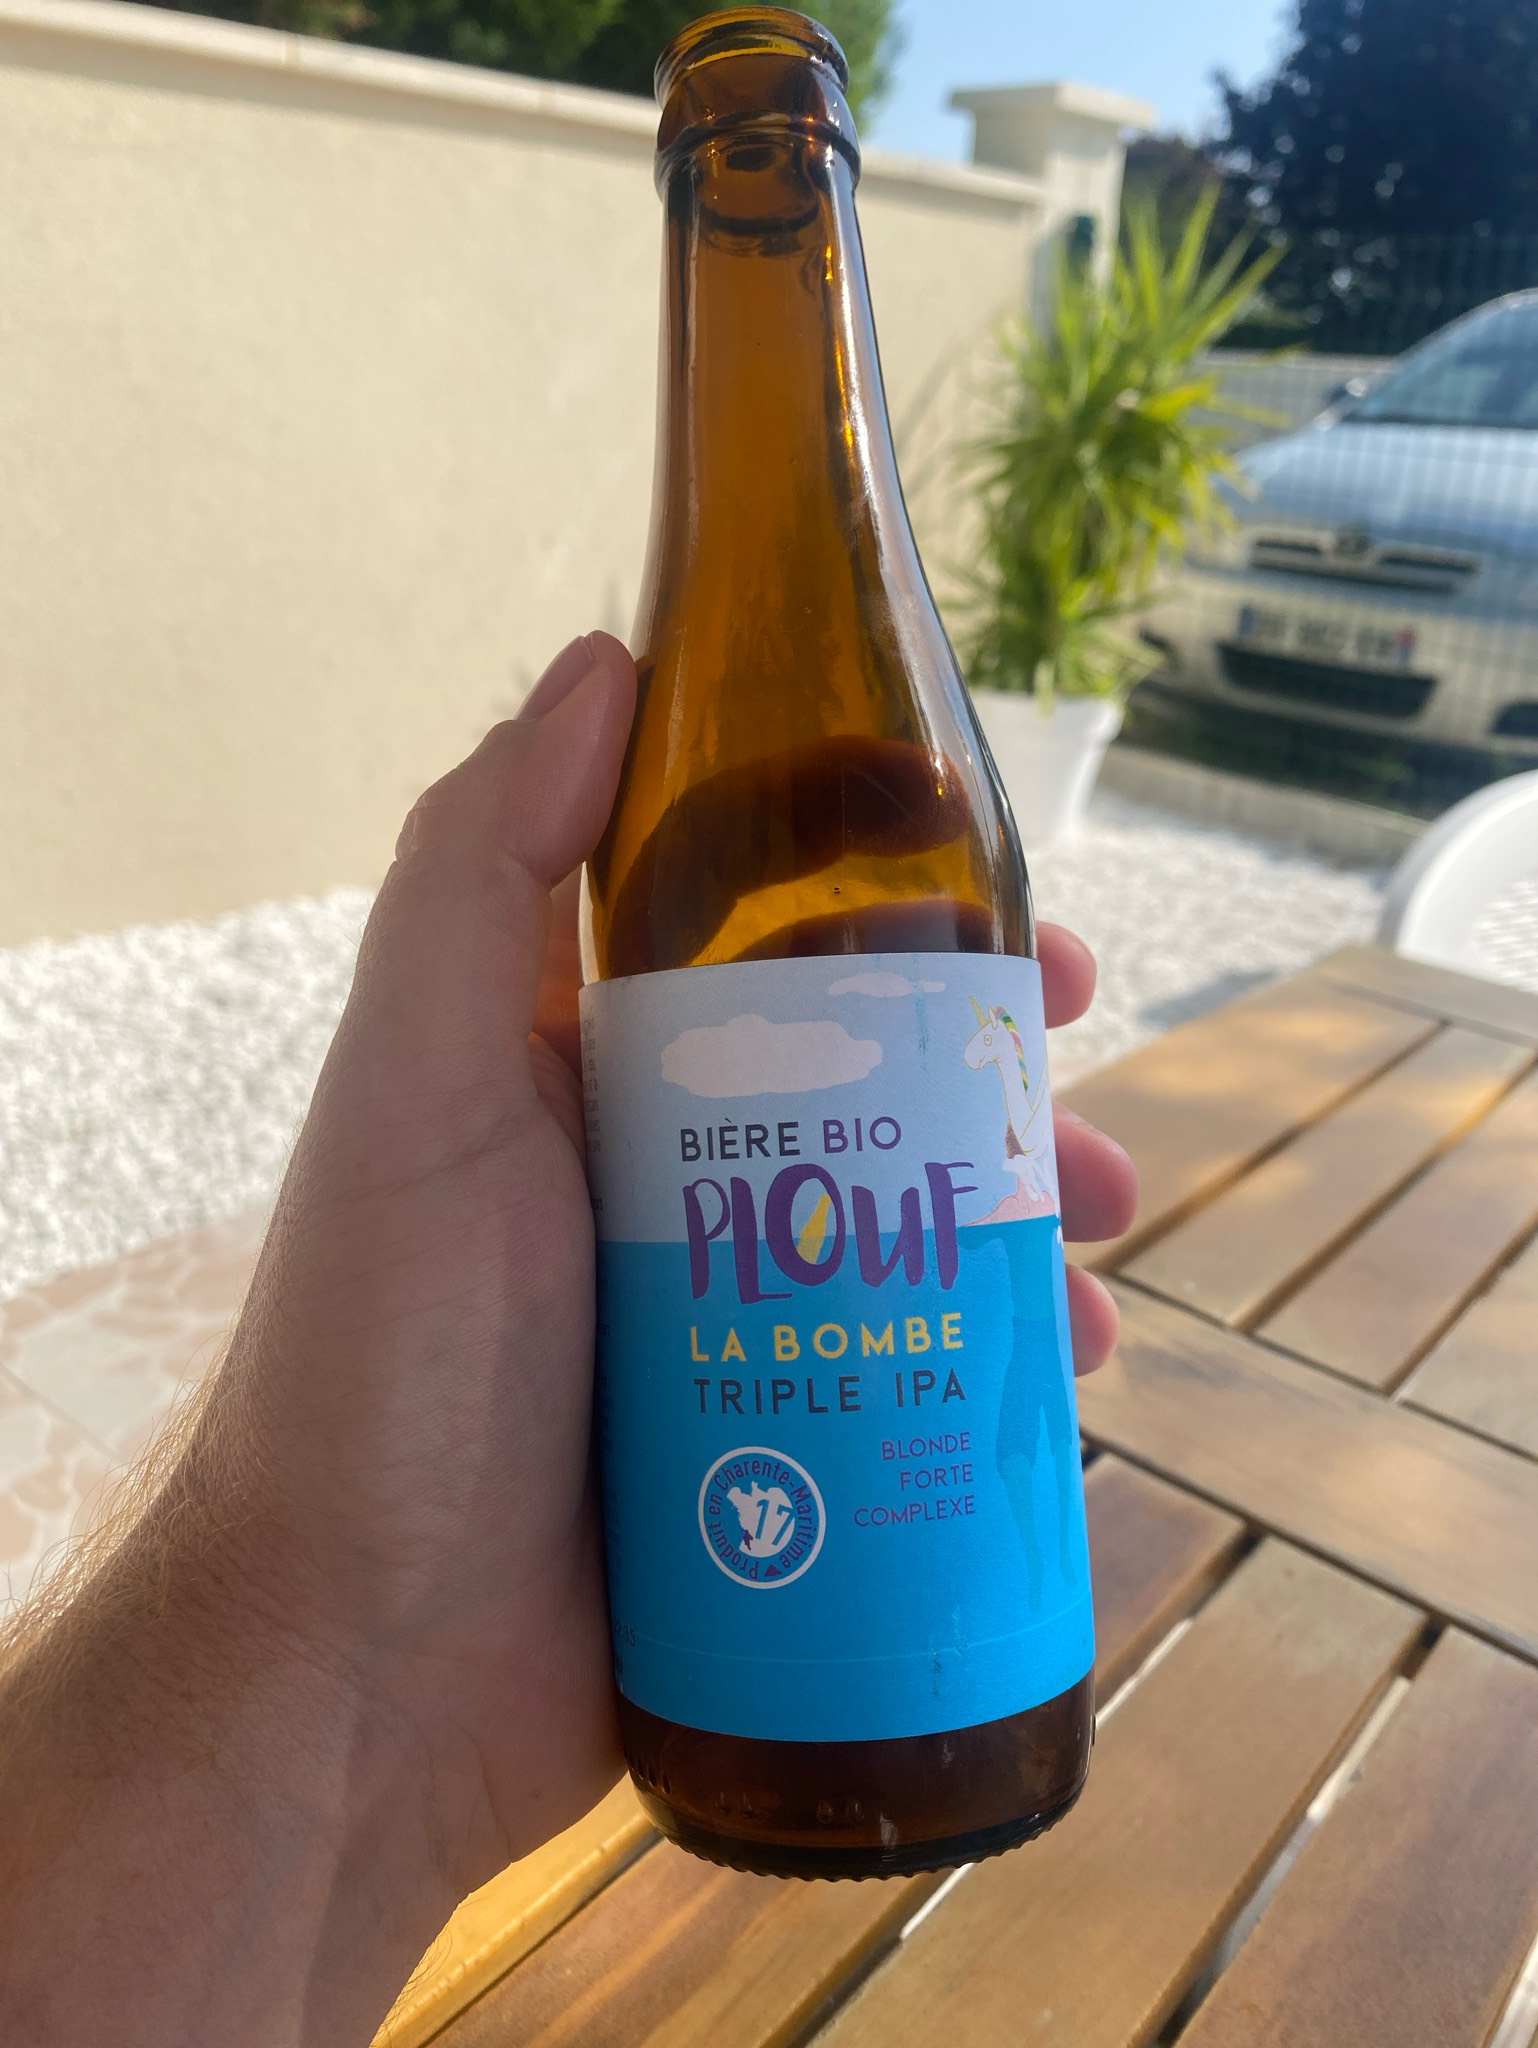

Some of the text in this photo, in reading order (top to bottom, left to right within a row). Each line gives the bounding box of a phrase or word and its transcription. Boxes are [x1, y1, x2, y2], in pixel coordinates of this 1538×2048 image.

[680, 1116, 902, 1162] BIÈRE BIO
[690, 1312, 964, 1362] LA BOMBE
[694, 1367, 967, 1414] TRIPLE IPA
[881, 1431, 971, 1461] BLONDE
[900, 1463, 974, 1491] FORTE
[708, 1493, 723, 1515] en
[756, 1498, 796, 1546] 17
[853, 1494, 976, 1528] COMPLEXE
[708, 1521, 760, 1580] Produit
